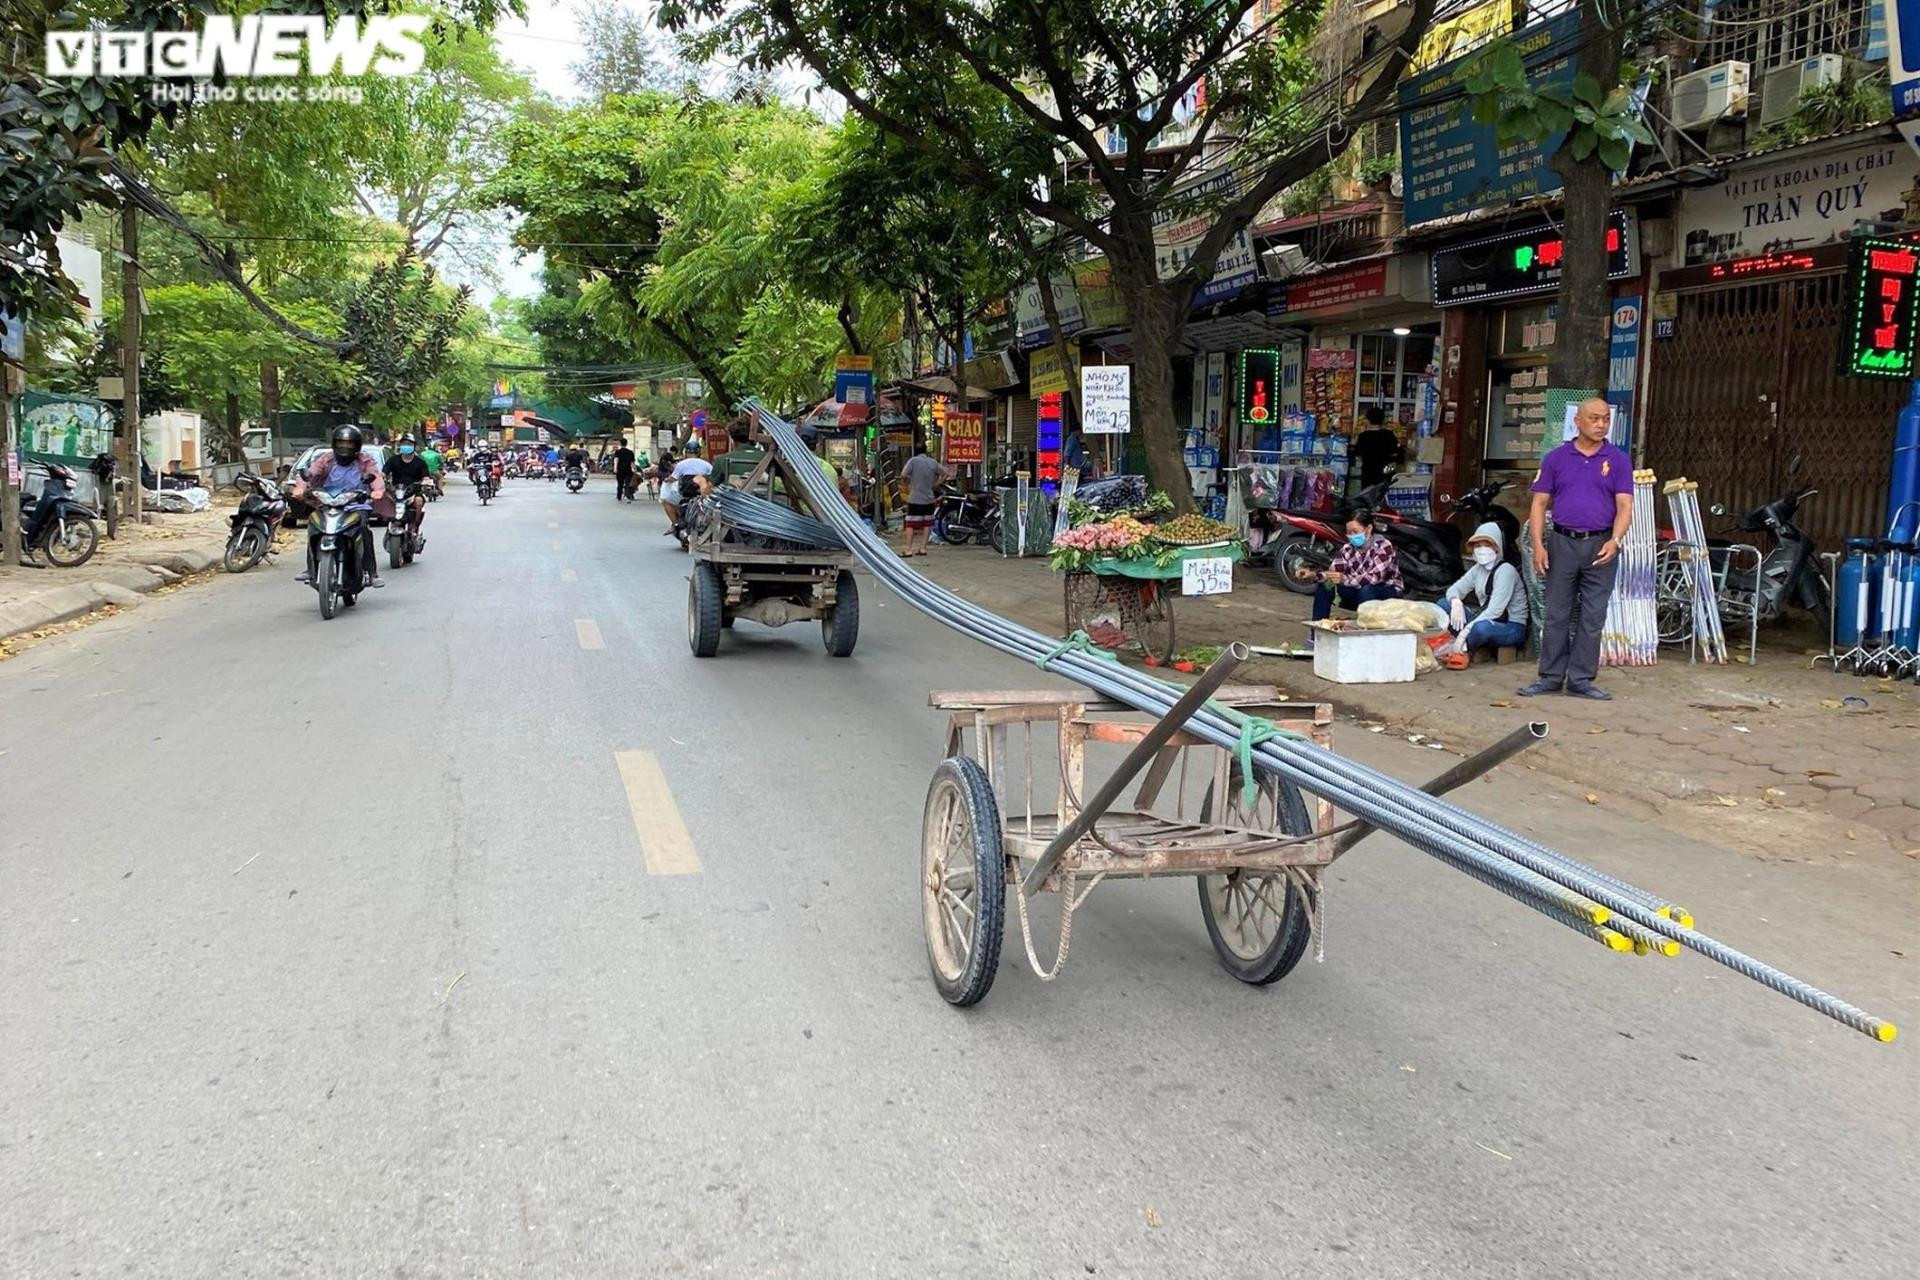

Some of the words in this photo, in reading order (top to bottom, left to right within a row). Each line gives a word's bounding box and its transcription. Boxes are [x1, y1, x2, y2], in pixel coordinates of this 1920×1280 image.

[1725, 181, 1747, 200] VẬT
[1774, 166, 1819, 189] KHOAN
[1825, 160, 1849, 180] ĐỊA
[1855, 149, 1895, 172] CHẤT
[1743, 192, 1802, 228] TRẦN
[1816, 175, 1868, 219] QUÝ
[1616, 310, 1635, 326] 174
[1883, 304, 1896, 322] Y
[1656, 321, 1672, 335] 172
